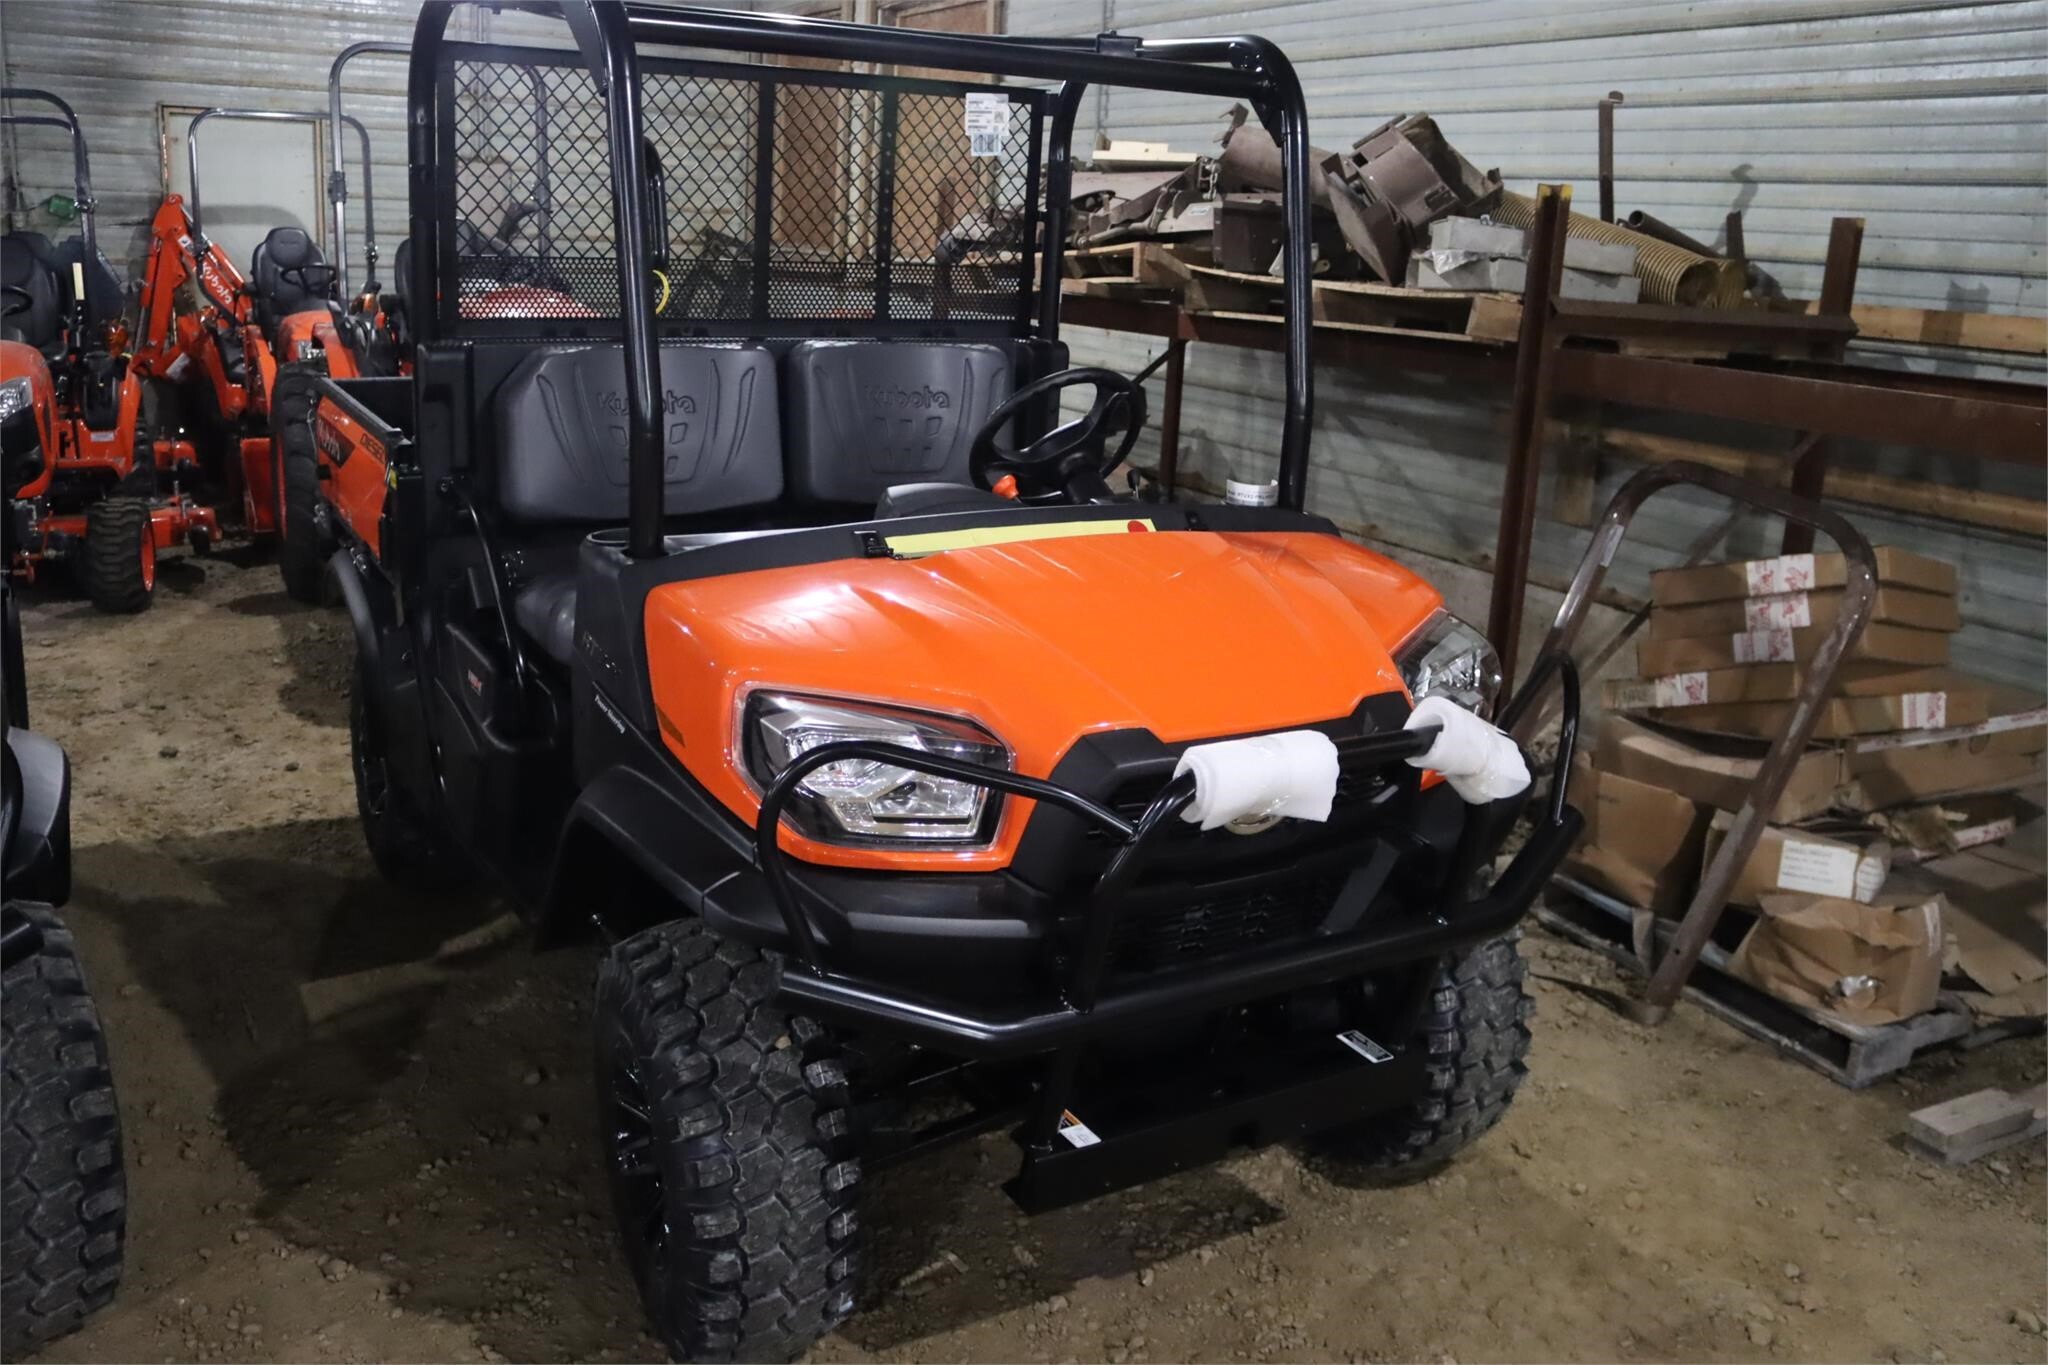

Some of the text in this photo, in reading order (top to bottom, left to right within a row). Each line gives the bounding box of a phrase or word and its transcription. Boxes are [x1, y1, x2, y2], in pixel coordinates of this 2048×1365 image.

[597, 389, 697, 416] Kuta
[863, 384, 950, 409] Kubota
[595, 693, 625, 734] Power Steering
